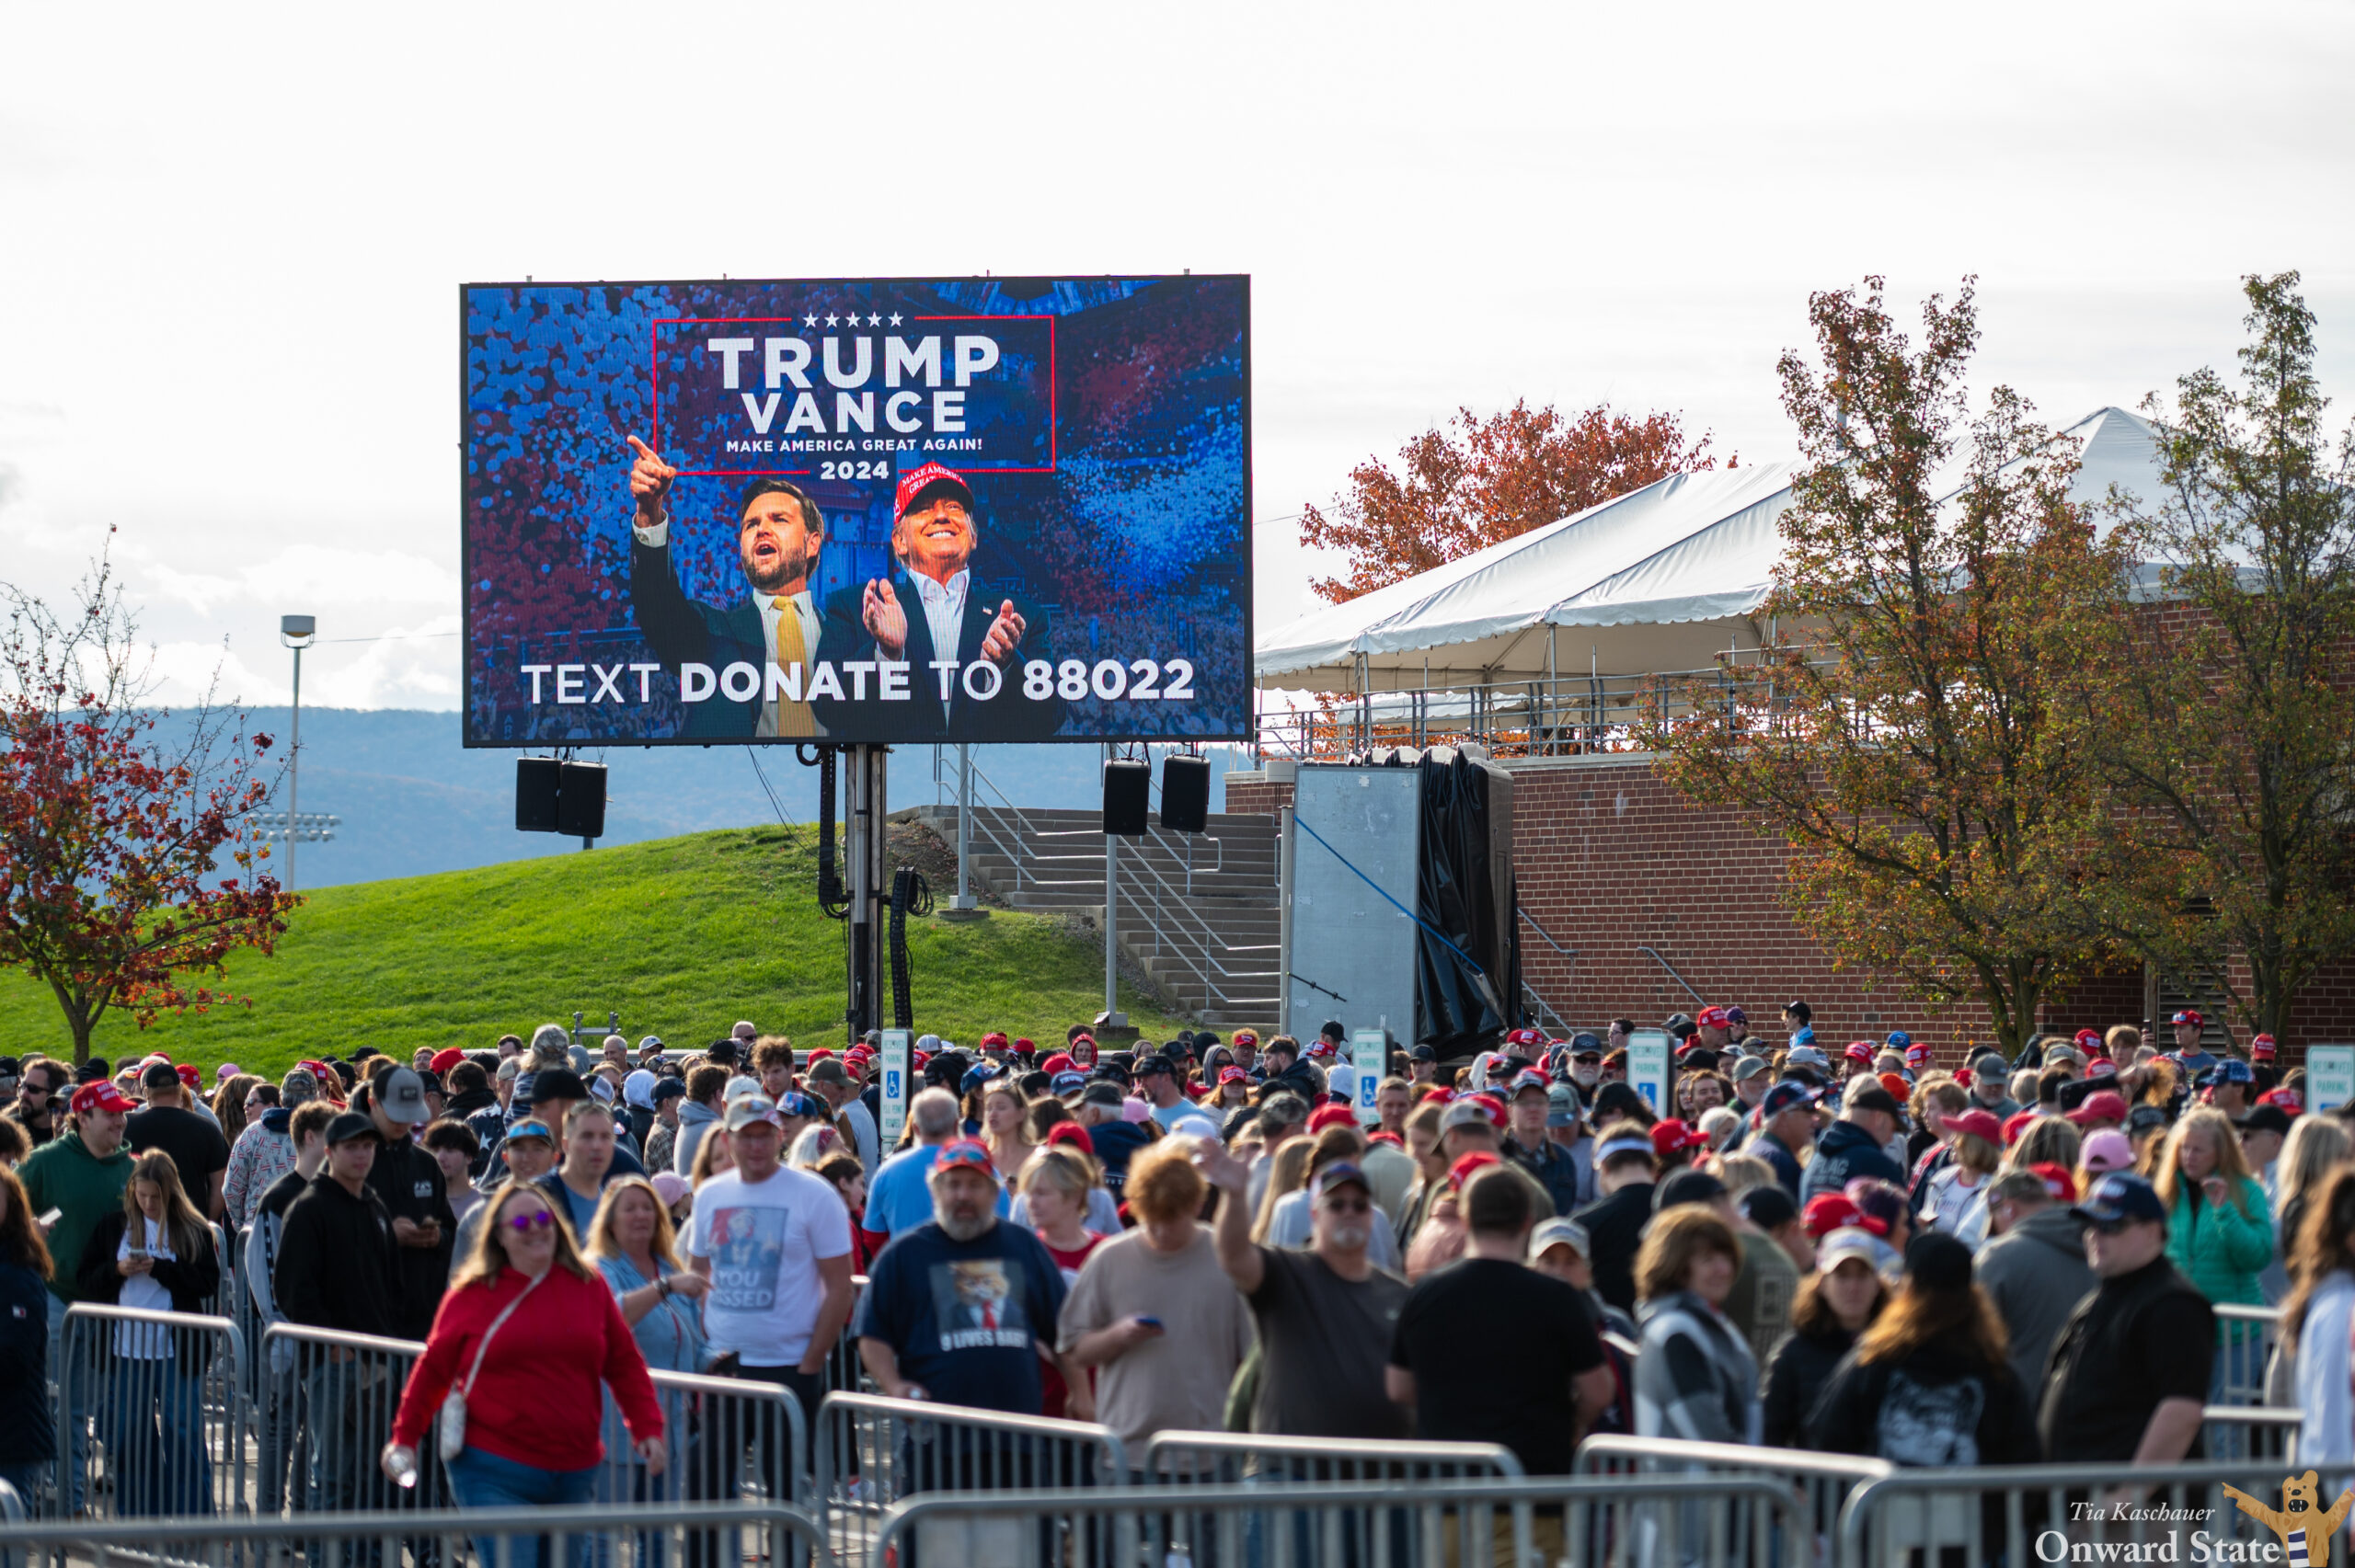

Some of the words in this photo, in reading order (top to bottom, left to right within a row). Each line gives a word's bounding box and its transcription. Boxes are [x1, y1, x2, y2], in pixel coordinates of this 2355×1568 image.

[707, 335, 1001, 389] TRUMP
[741, 391, 966, 434] VANCE
[726, 440, 774, 452] MAKE
[779, 439, 856, 452] AMERICA
[862, 439, 917, 452] GREAT
[923, 438, 982, 451] AGAIN!
[821, 461, 890, 480] 2024
[902, 467, 927, 487] MAKE
[521, 663, 661, 704] TEXT
[681, 661, 911, 702] DONATE
[928, 660, 1002, 701] TO
[1023, 658, 1195, 701] 88022
[1636, 1063, 1660, 1074] PARKING
[2316, 1081, 2349, 1094] PARKING
[718, 1270, 761, 1288] YOU
[940, 1332, 953, 1352] 9
[953, 1329, 994, 1349] LIVES
